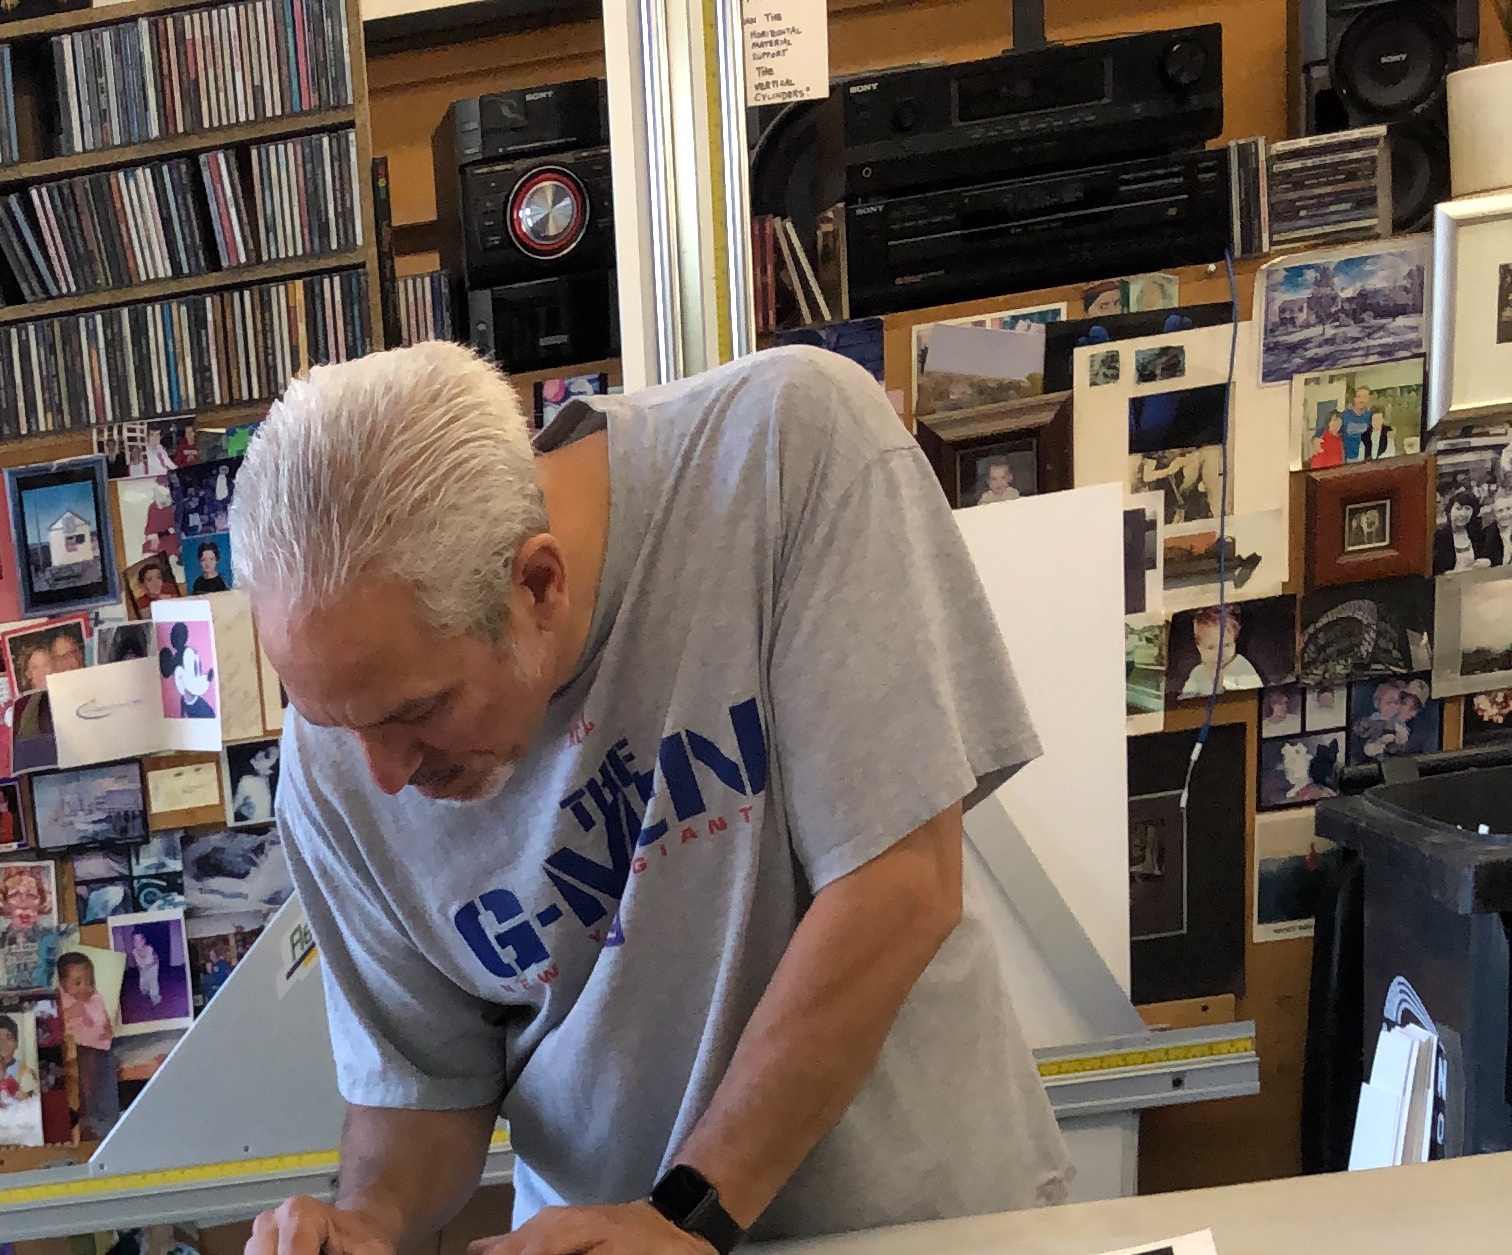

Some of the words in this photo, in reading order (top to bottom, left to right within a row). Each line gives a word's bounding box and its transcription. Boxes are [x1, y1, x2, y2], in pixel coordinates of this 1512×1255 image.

[753, 78, 796, 92] VERTICAL
[849, 82, 879, 94] SONY
[525, 90, 554, 102] SONY
[855, 204, 885, 216] SONY
